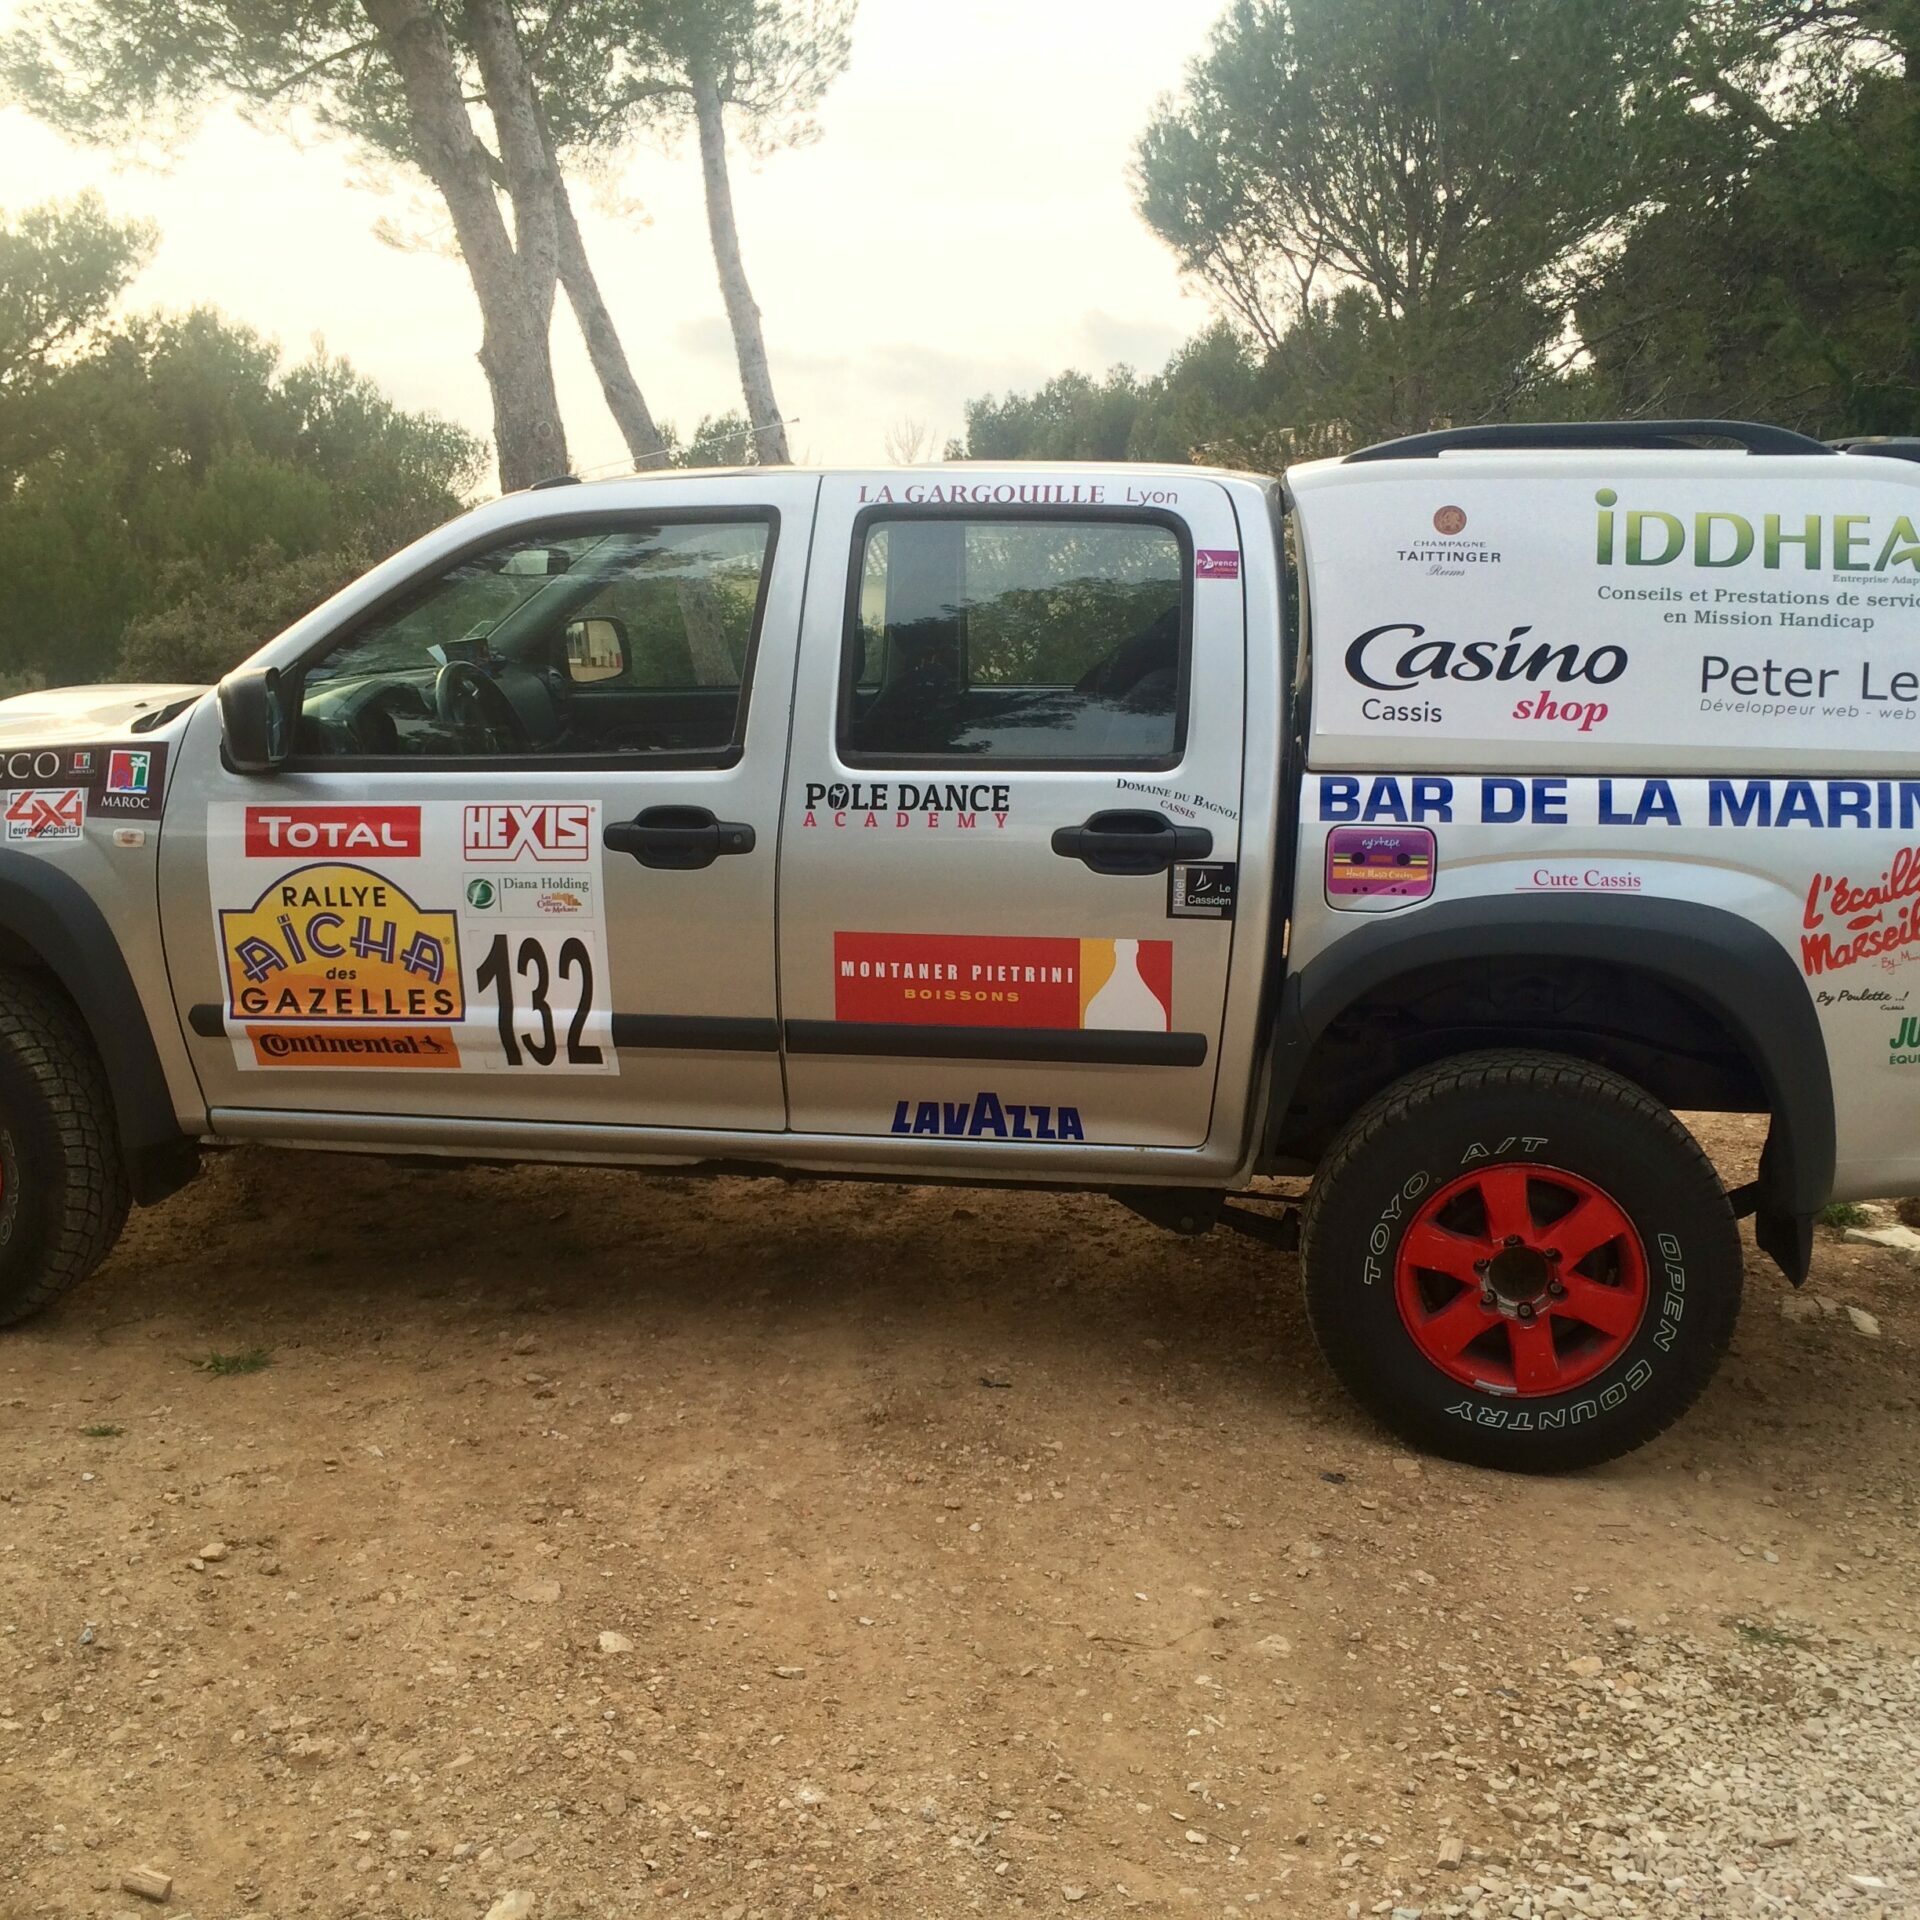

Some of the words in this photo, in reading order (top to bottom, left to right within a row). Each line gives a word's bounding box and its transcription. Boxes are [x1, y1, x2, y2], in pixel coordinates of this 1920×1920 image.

[859, 485, 894, 503] LA
[905, 485, 1105, 504] GARGOUILLE
[1127, 486, 1178, 506] Lyon
[1413, 540, 1487, 548] CHAMPAGNE
[1397, 551, 1501, 562] TAITTINGER
[1833, 574, 1889, 585] Entreprise
[1597, 585, 1683, 602] Conseils
[1689, 589, 1708, 602] et
[1715, 588, 1830, 606] Prestations
[1836, 592, 1860, 606] de
[1664, 612, 1687, 624] en
[1694, 610, 1772, 626] Mission
[1780, 612, 1875, 632] Handicap
[1344, 623, 1629, 691] Casino
[1701, 655, 1839, 698] Peter
[1362, 698, 1443, 723] Cassis
[1512, 690, 1609, 732] shop
[1700, 698, 1816, 717] Développeur
[1822, 704, 1860, 718] web
[1879, 707, 1917, 720] web
[0, 751, 60, 779] CCO
[101, 796, 150, 809] MAROC
[805, 783, 888, 811] POLE
[898, 784, 1010, 812] DANCE
[1160, 800, 1197, 819] CASSIS
[1319, 776, 1454, 823] BAR
[1480, 778, 1568, 825] DE
[1598, 779, 1682, 826] LA
[258, 816, 408, 848] TOTAL
[803, 812, 1008, 829] ACADEMY
[464, 805, 589, 861] HEXIS
[503, 878, 538, 890] Diana
[541, 878, 589, 892] Holding
[1219, 883, 1231, 893] Le
[1534, 870, 1579, 887] Cute
[1584, 869, 1641, 887] Cassis
[282, 886, 387, 907] RALLYE
[1174, 879, 1185, 907] Hotel
[1187, 894, 1232, 906] Cassiden
[325, 967, 357, 980] des
[841, 960, 958, 981] MONTANER
[972, 965, 1074, 984] PIETRINI
[240, 987, 454, 1016] GAZELLES
[476, 934, 603, 1066] 132
[904, 988, 1020, 1003] BOISSONS
[1816, 991, 1836, 1006] By
[1837, 988, 1892, 1002] Poulette
[259, 1033, 420, 1057] Continental
[891, 1092, 1085, 1140] LAVAZZA
[1461, 1137, 1549, 1164] A/T
[1364, 1170, 1430, 1285] TOYO
[1653, 1233, 1685, 1352] OPEN
[1444, 1359, 1653, 1431] COUNTRY
